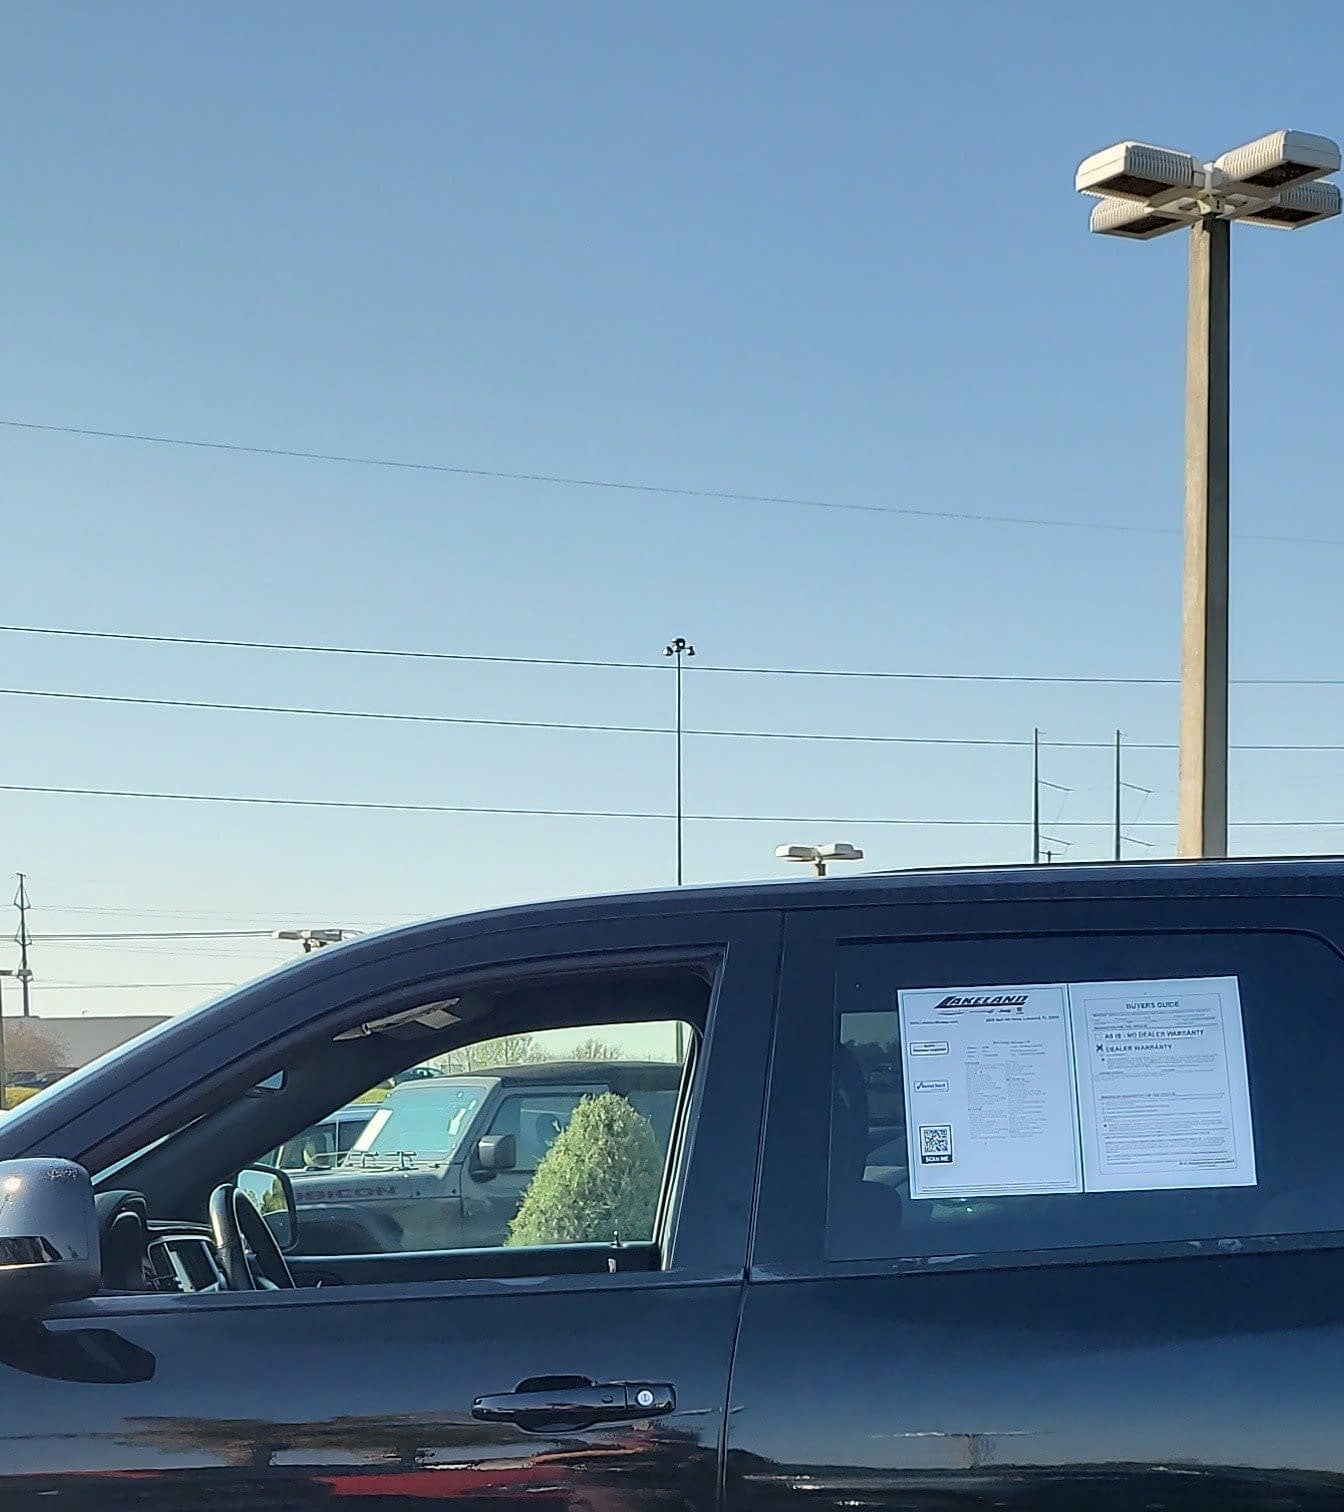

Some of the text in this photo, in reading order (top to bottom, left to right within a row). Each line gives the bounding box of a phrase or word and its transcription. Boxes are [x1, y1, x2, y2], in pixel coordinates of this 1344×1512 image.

[935, 995, 1029, 1010] LAKELAND
[1138, 1030, 1166, 1038] DEALER
[1166, 1029, 1204, 1037] WARRANTY
[1106, 1045, 1134, 1053] DEALER
